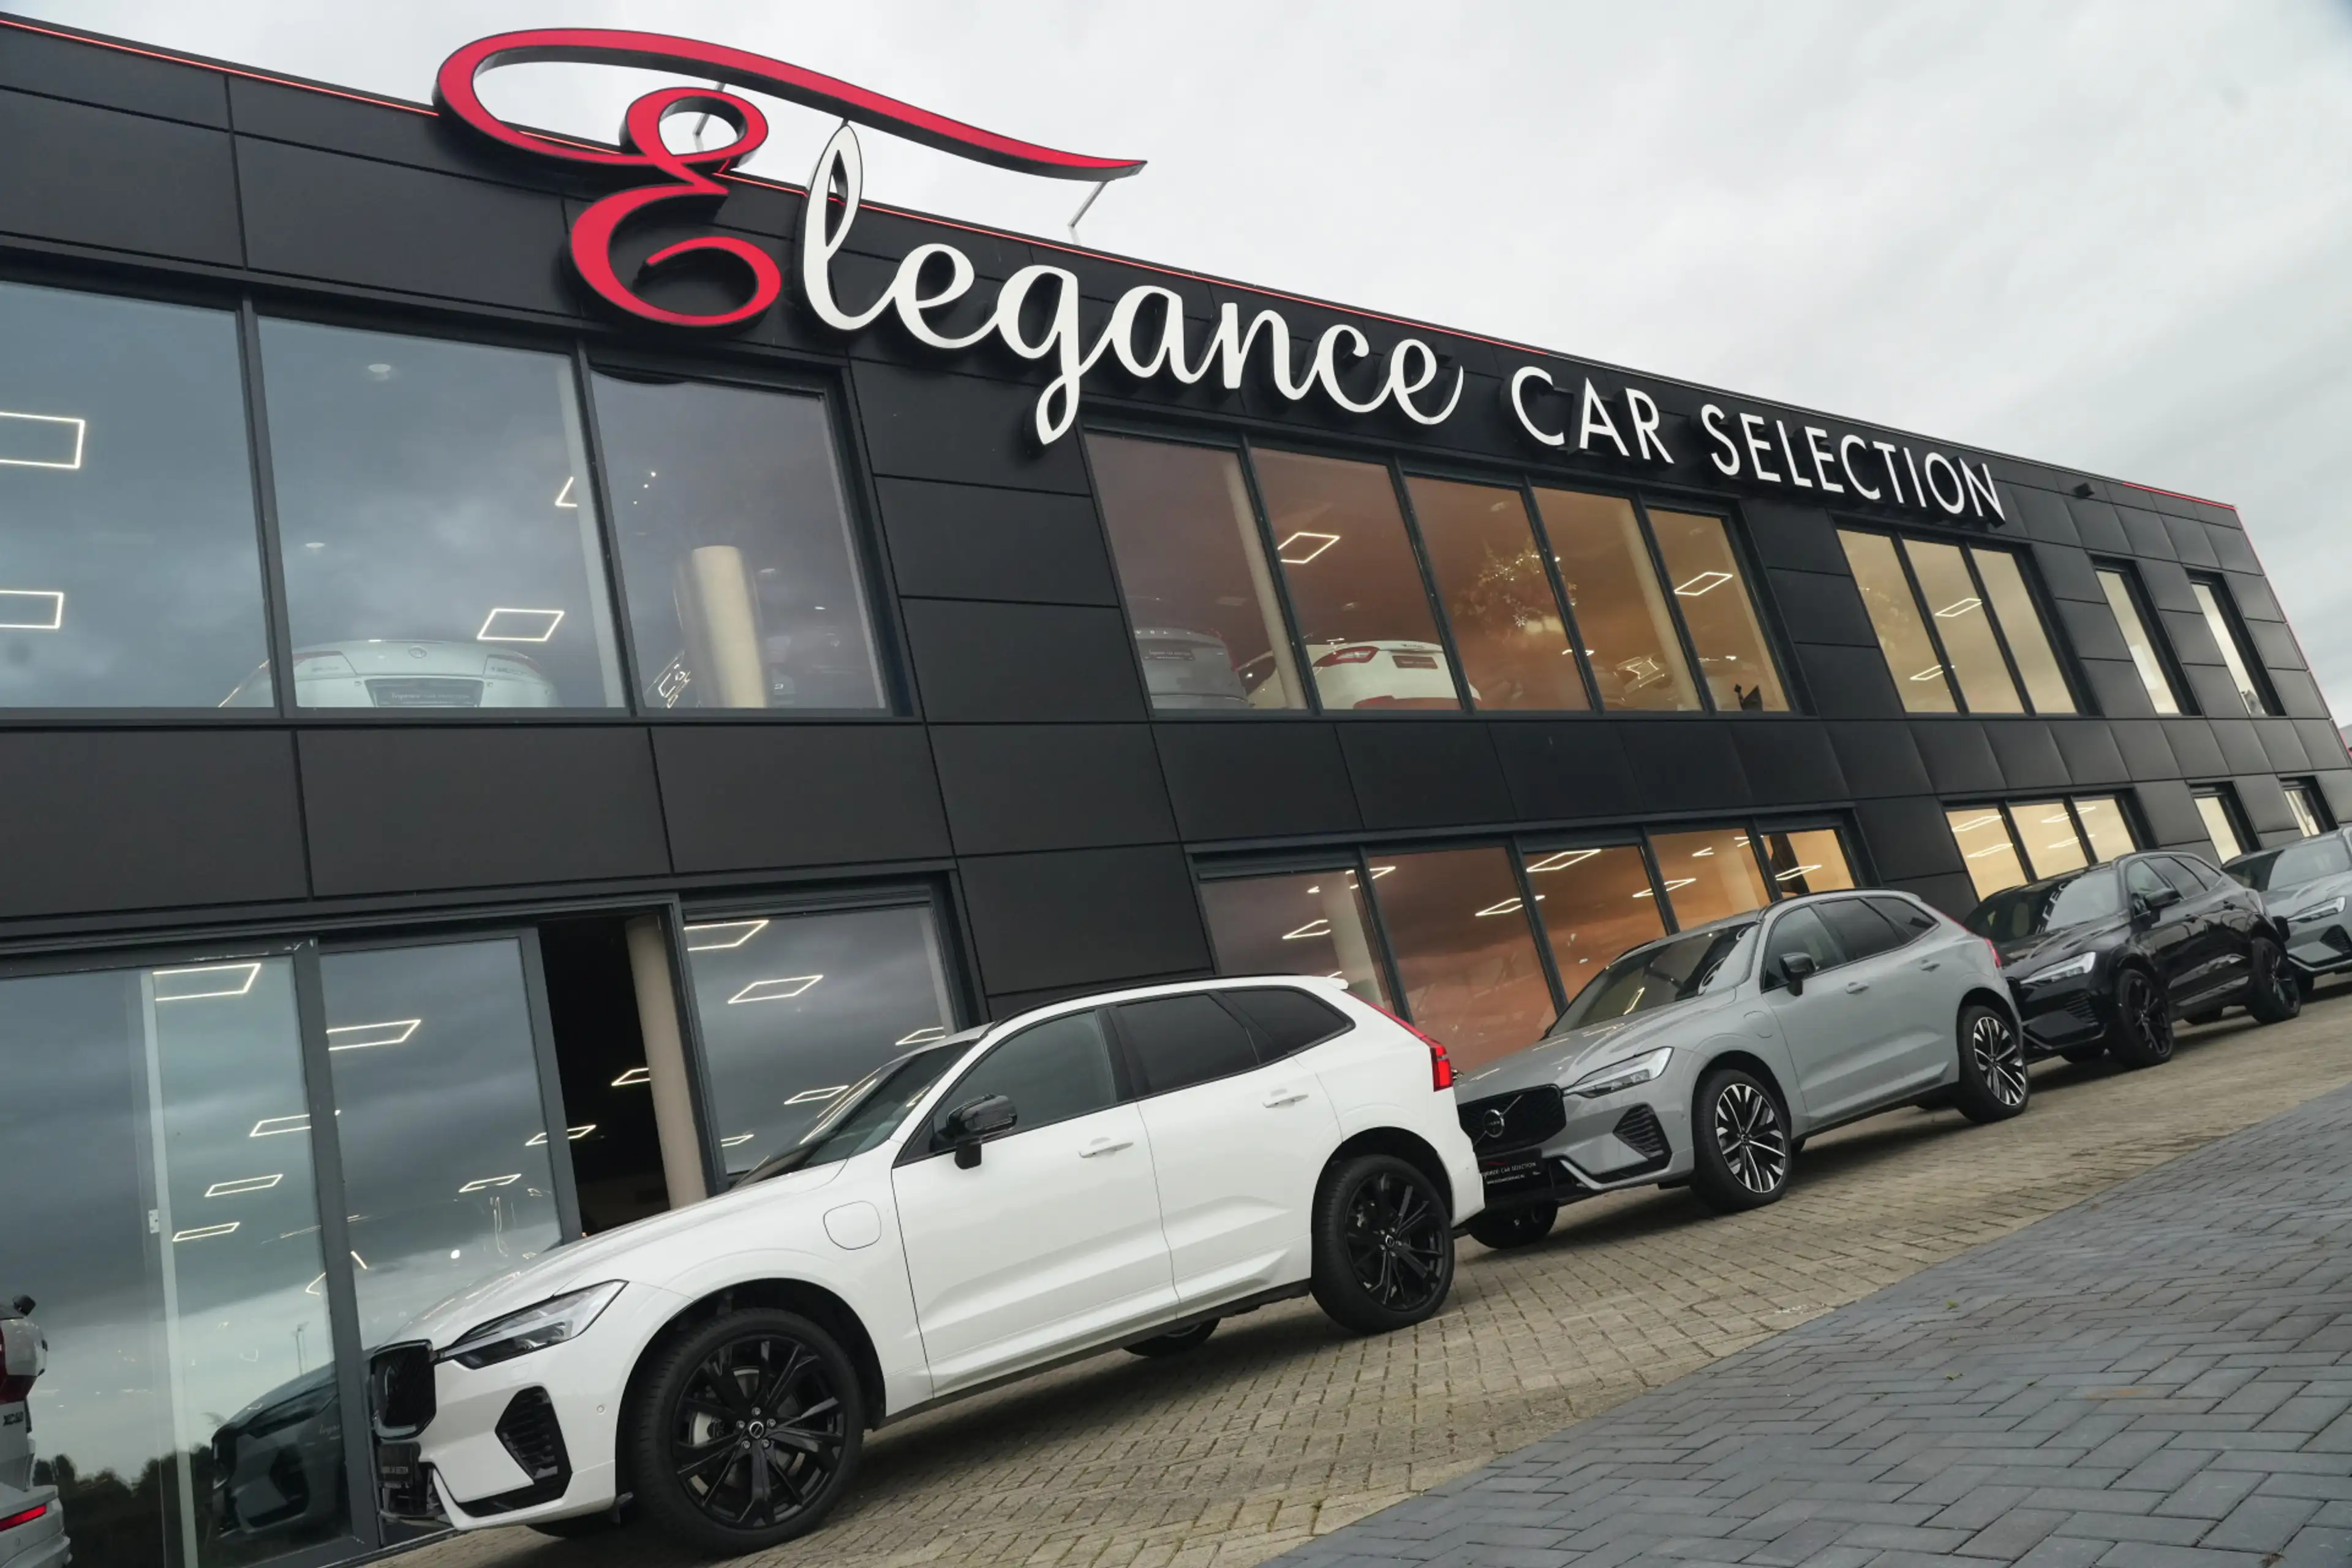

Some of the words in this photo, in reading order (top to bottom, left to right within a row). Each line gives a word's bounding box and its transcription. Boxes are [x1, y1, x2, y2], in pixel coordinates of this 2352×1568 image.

[435, 28, 1464, 446] Elegance
[1510, 366, 1675, 464] CAR
[1700, 403, 2007, 521] SELECTION
